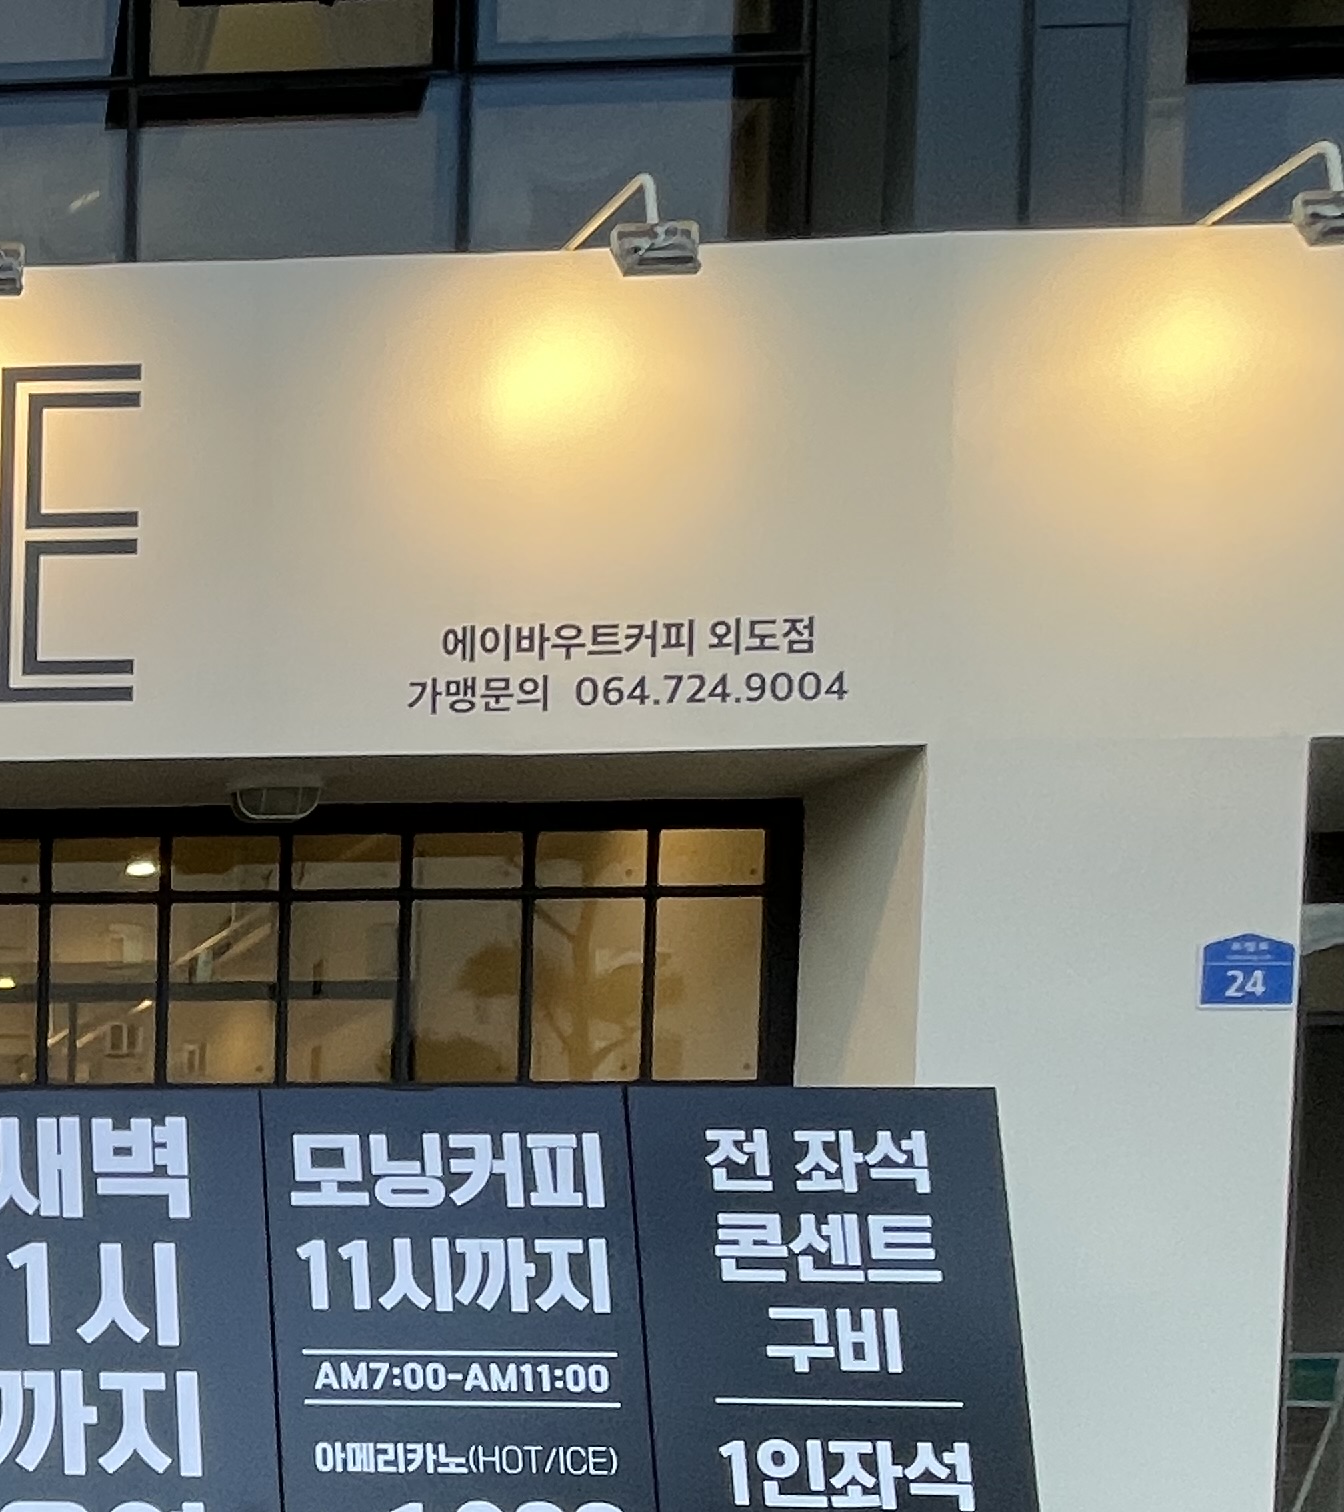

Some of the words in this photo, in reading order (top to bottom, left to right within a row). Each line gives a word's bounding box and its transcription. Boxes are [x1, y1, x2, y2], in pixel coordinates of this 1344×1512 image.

[441, 618, 696, 662] 에이바우트커피
[708, 616, 816, 656] 외도점
[406, 674, 550, 715] 가맹문의
[574, 670, 850, 706] 064.724.9004
[1224, 969, 1266, 998] 24
[290, 1131, 607, 1208] 모닝커피
[704, 1128, 774, 1192] 전
[793, 1129, 931, 1194] 좌석
[295, 1236, 612, 1314] 11시까지
[714, 1211, 944, 1283] 콘센트
[6, 1241, 181, 1347] 1시
[766, 1306, 904, 1374] 구비
[314, 1361, 610, 1393] AM7:00-AM11:00
[314, 1442, 619, 1476] 아메리카노(HOT/ICE)
[718, 1438, 977, 1512] 1인좌석
